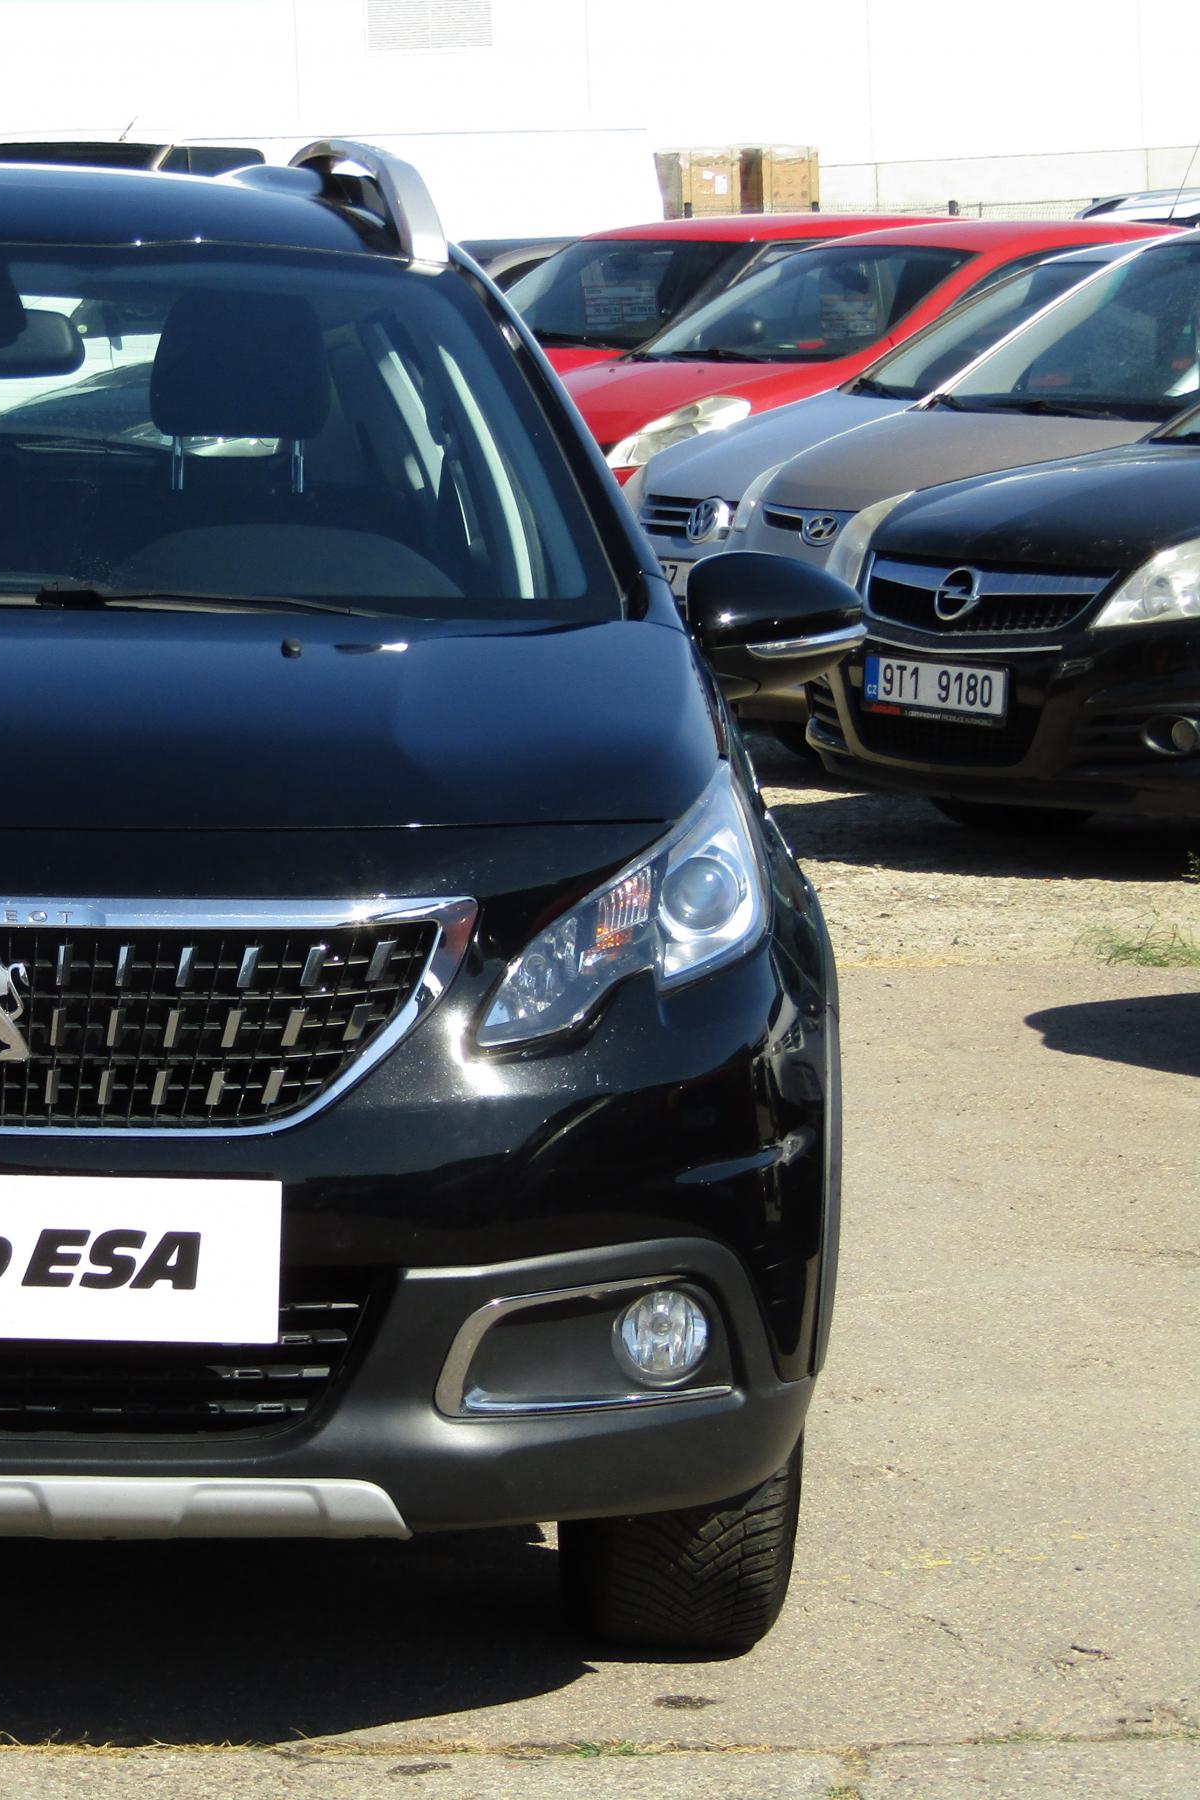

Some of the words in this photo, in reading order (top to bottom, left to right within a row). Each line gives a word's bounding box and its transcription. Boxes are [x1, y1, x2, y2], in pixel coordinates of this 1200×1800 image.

[882, 663, 920, 700] 9T1
[937, 670, 993, 708] 9180
[21, 1228, 202, 1290] ESA
